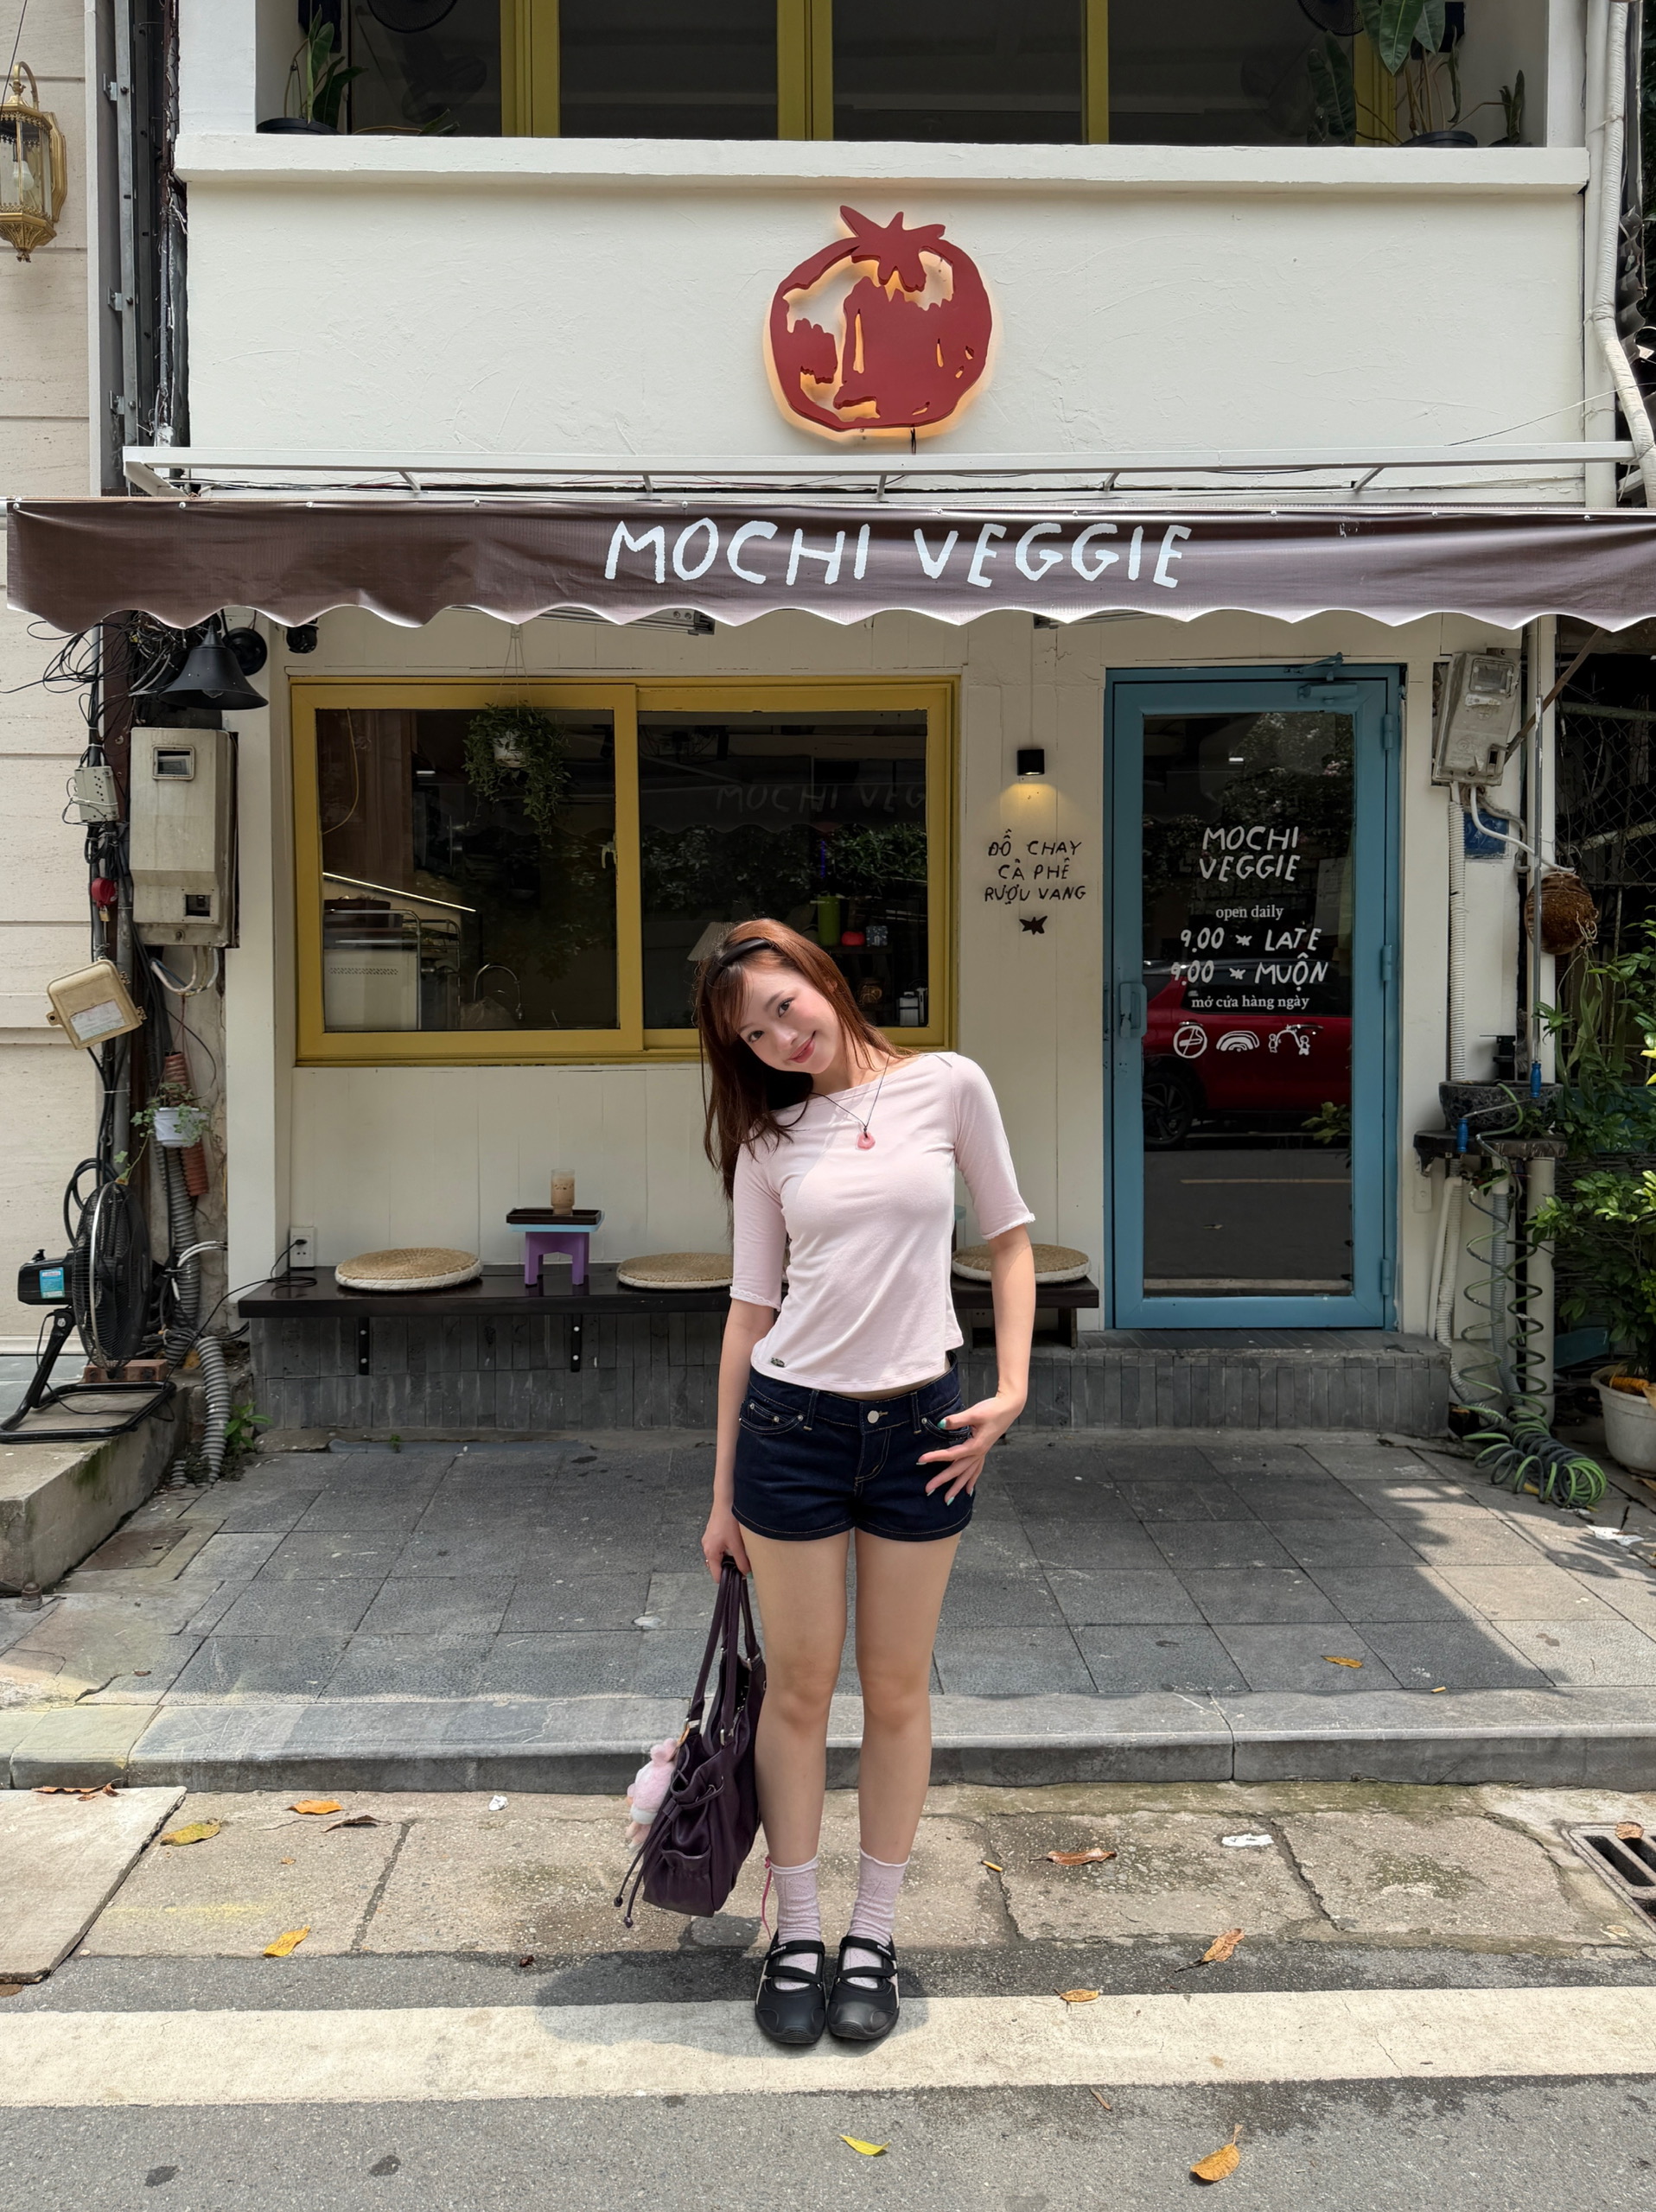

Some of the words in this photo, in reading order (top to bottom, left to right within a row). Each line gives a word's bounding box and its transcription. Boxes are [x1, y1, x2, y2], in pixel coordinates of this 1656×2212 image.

[605, 518, 869, 585] MOCHI
[914, 523, 1192, 588] VEGGIE
[988, 829, 1012, 856] ĐỒ
[1027, 840, 1082, 855] CHAY
[1202, 825, 1299, 850] MOCHI
[998, 858, 1025, 880] CÀ
[1034, 857, 1071, 880] PHÊ
[1199, 855, 1301, 882] VEGGIE
[984, 884, 1031, 905] RƯỢU
[1038, 886, 1086, 900] VANG
[1215, 907, 1248, 921] open
[1251, 905, 1284, 920] daily
[1181, 927, 1225, 952] 9.00
[1264, 928, 1322, 951] LATE
[1254, 952, 1328, 992] MUỘN
[1191, 996, 1213, 1008] mở
[1215, 995, 1239, 1008] cửa
[1242, 995, 1275, 1010] hàng
[1277, 996, 1310, 1010] ngày
